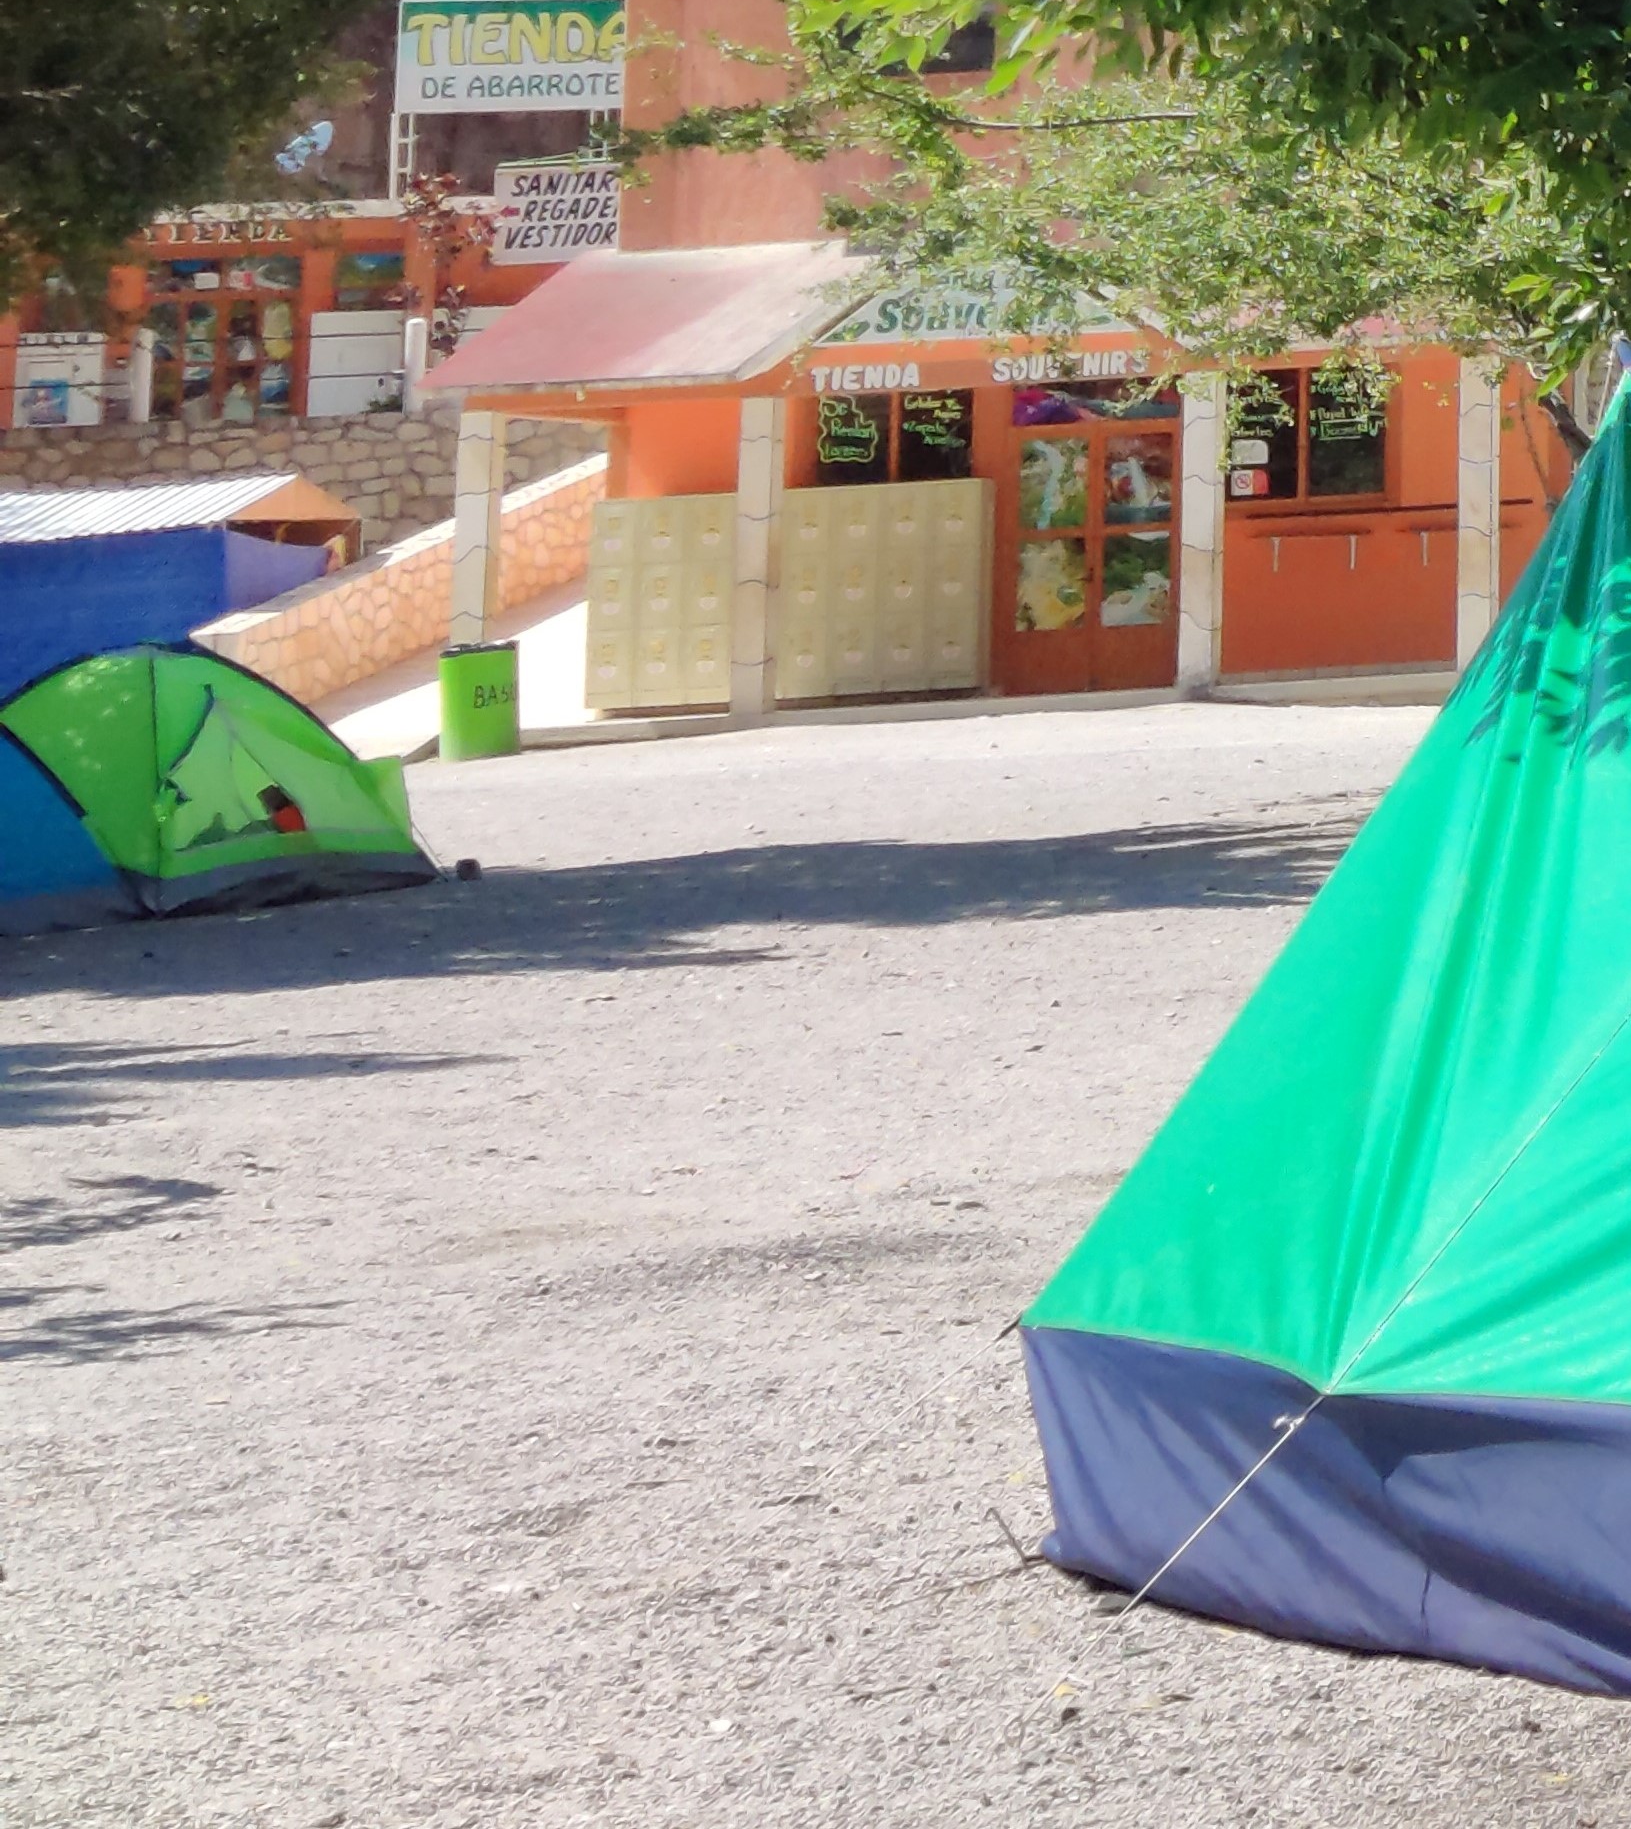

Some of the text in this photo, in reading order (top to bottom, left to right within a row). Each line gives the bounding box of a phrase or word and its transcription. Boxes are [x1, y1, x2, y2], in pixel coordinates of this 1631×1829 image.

[407, 11, 625, 66] TIENDA
[421, 73, 620, 99] DE ABARROTE
[811, 362, 920, 392] TIENDA
